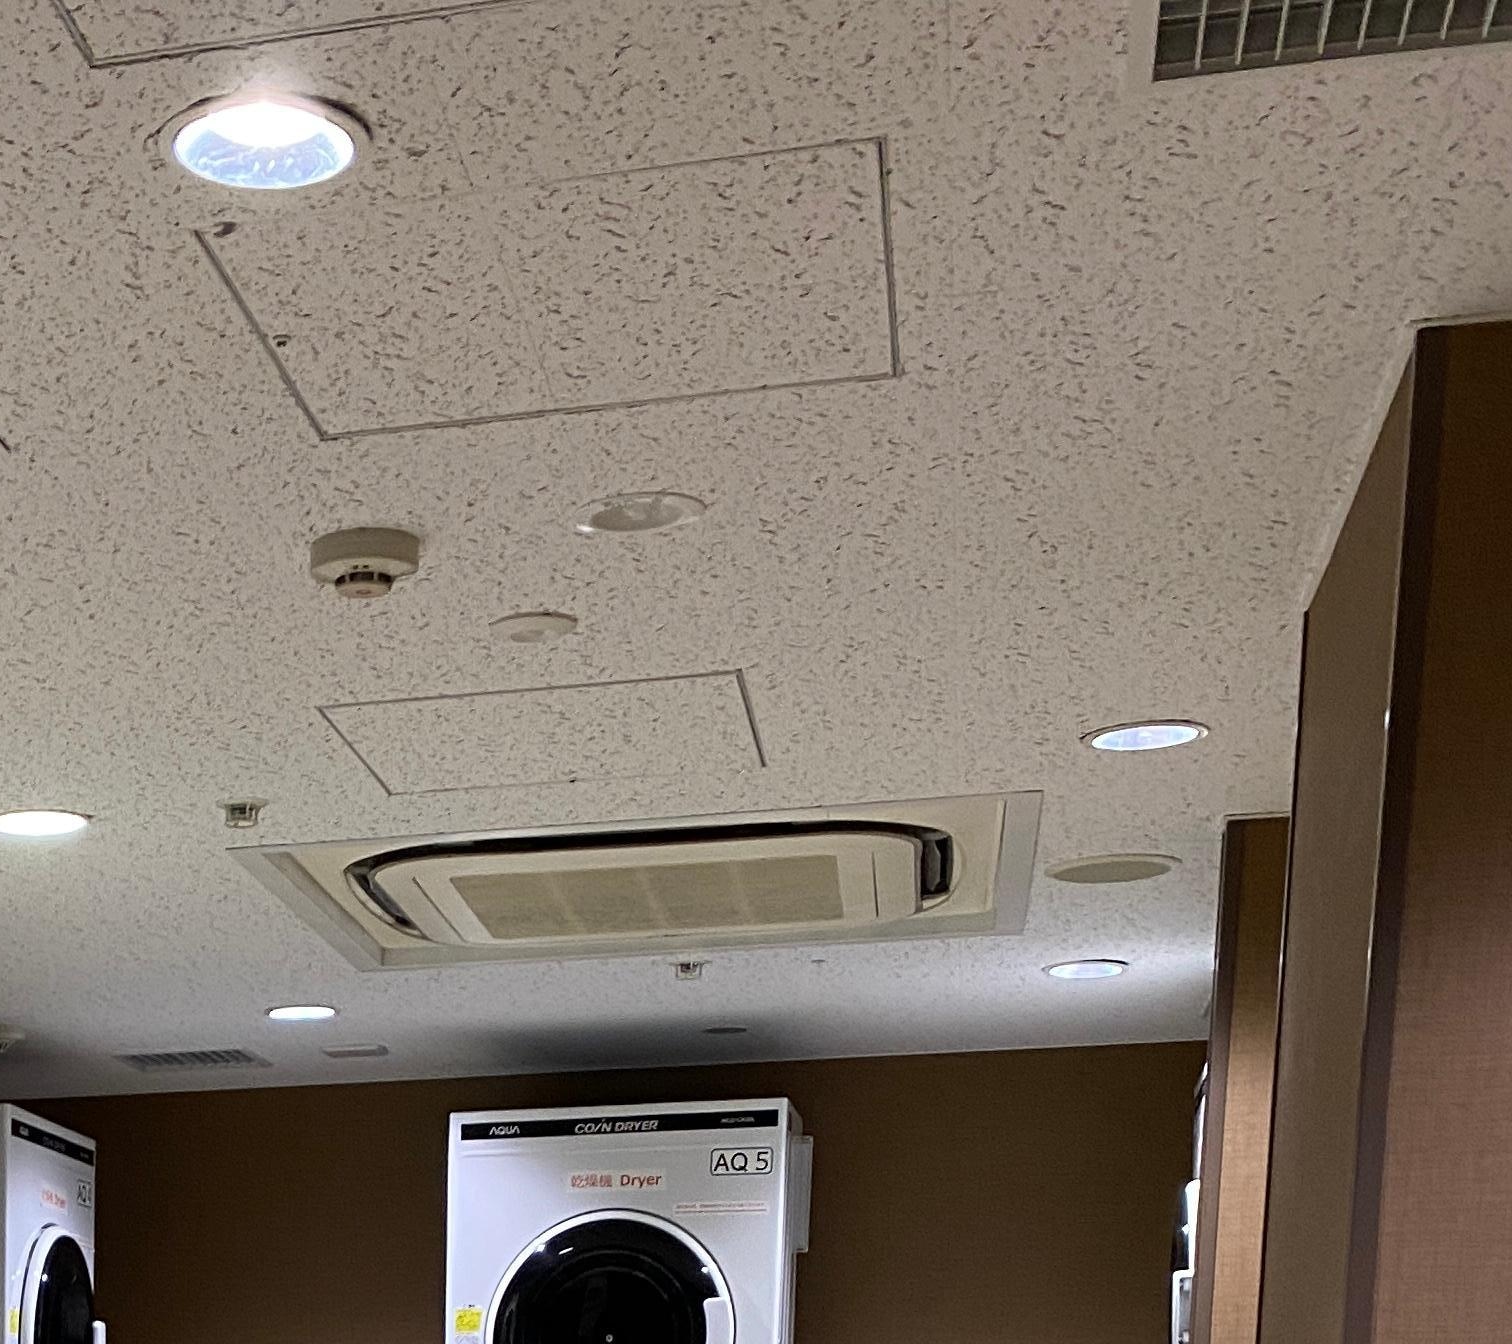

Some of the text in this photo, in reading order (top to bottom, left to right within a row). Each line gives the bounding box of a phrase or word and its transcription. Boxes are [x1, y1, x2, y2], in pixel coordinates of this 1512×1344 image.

[489, 1124, 521, 1135] AQUA
[614, 1119, 659, 1132] DRYER
[713, 1151, 769, 1174] AQ 5
[620, 1173, 662, 1189] Dryer
